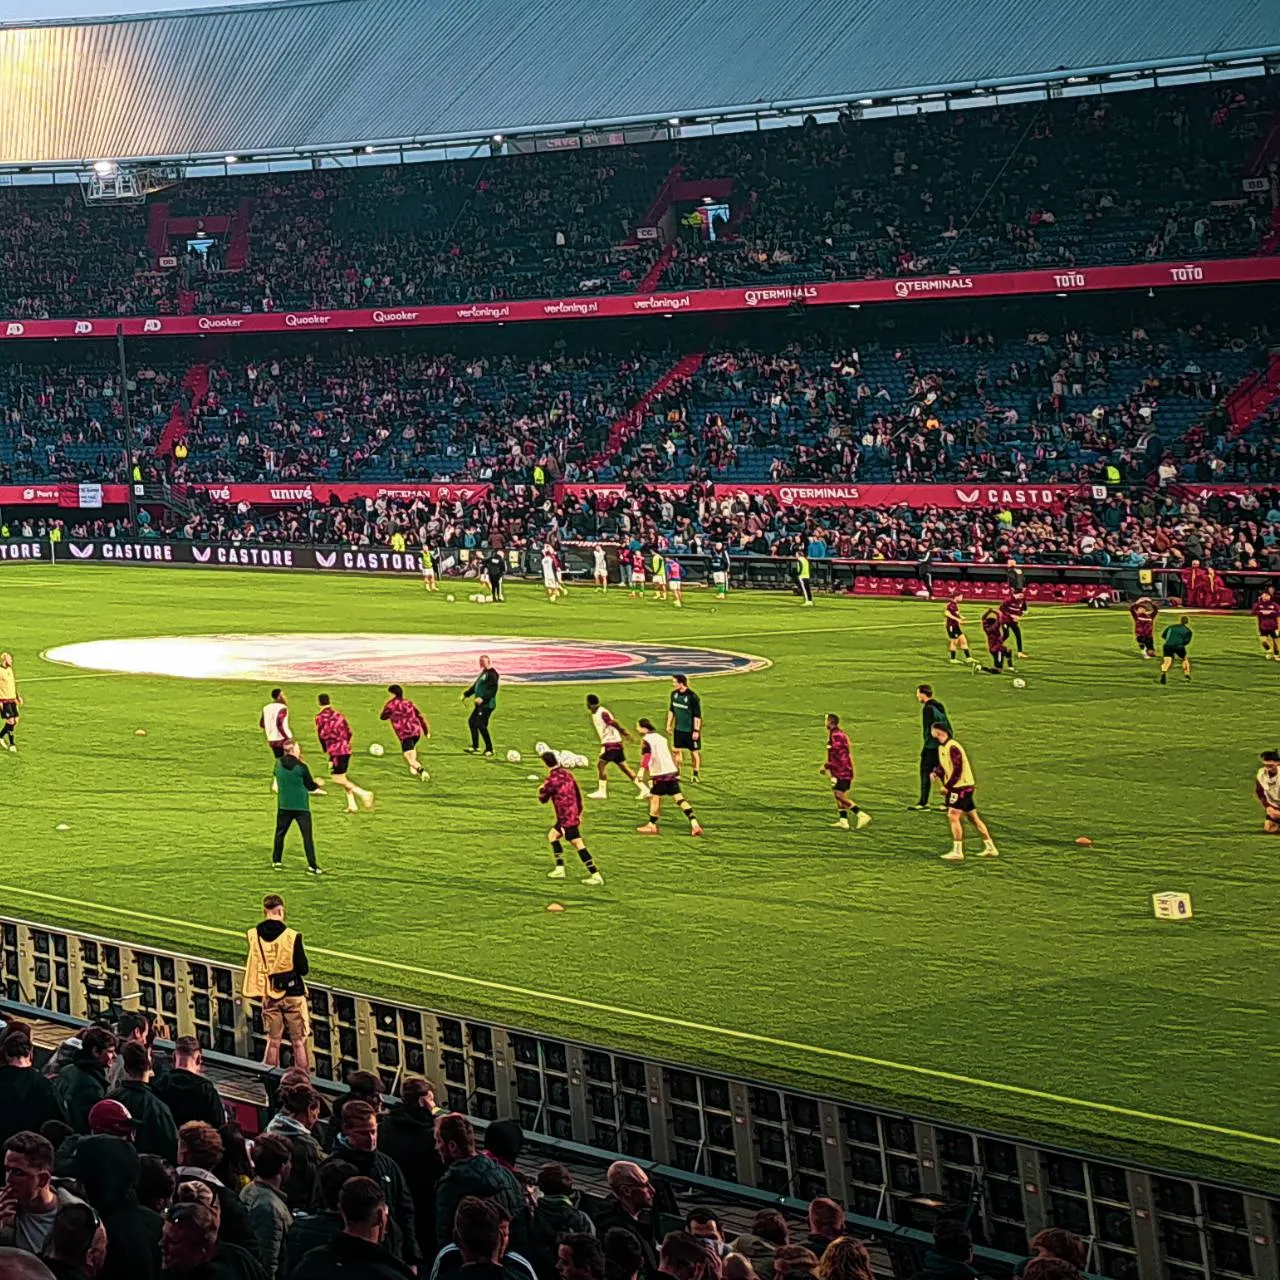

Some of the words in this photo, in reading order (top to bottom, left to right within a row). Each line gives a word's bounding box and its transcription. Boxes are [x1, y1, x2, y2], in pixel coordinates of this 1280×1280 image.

[1054, 272, 1085, 287] TOTO
[1169, 264, 1203, 281] TOTO
[895, 278, 973, 297] QTERMINALS
[543, 301, 598, 314] verloning.nl
[634, 296, 690, 309] verloning.nl
[373, 311, 418, 322] Quooker
[457, 306, 509, 318] verloning.nl
[198, 317, 243, 329] Quooker
[285, 314, 330, 326] Quooker
[271, 485, 313, 500] univé
[780, 487, 858, 503] QTERMINALS
[102, 543, 173, 560] CASTORE
[217, 548, 293, 565] CASTORE
